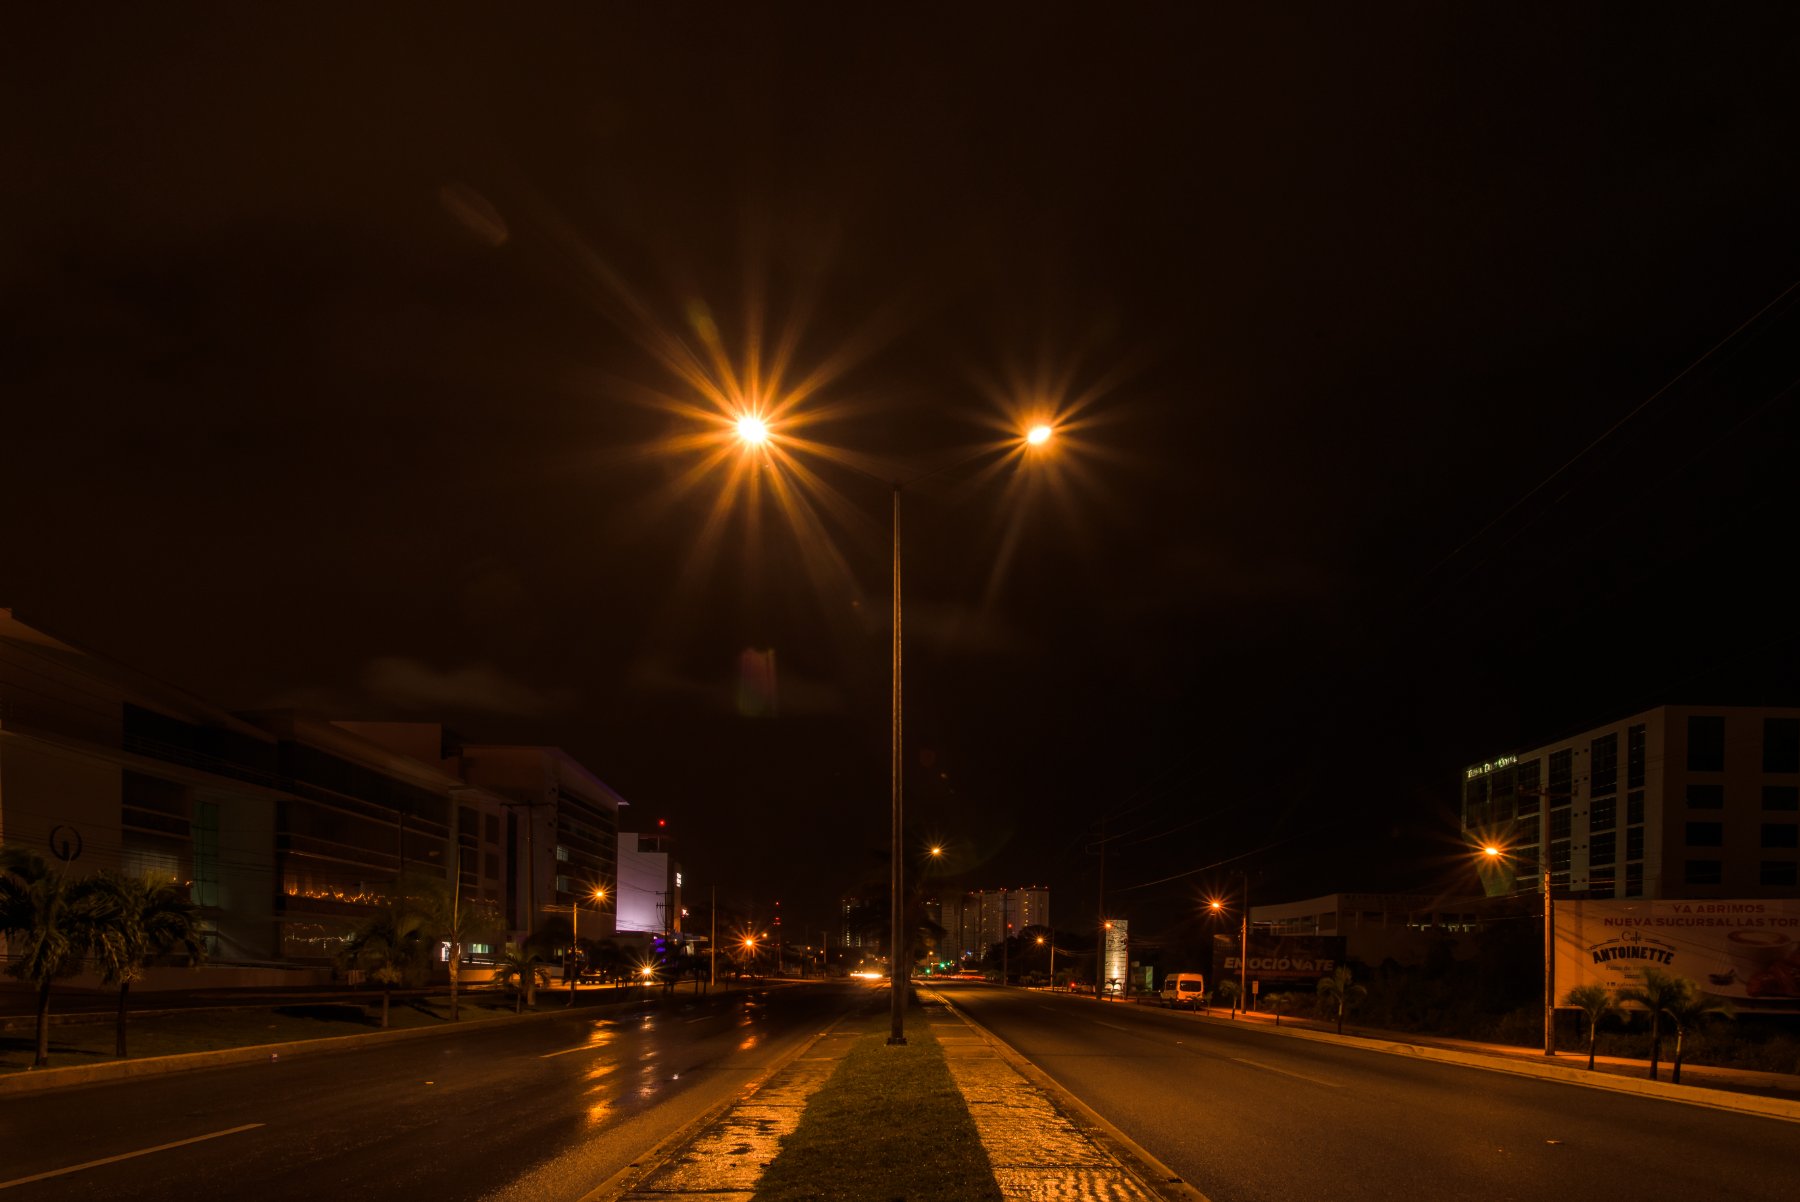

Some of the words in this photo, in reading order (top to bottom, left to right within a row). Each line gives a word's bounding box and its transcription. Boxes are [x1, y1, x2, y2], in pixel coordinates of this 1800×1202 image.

[1672, 904, 1692, 913] YA
[1696, 904, 1765, 913] ABRIMOS
[1604, 918, 1653, 927] NUEVA
[1655, 918, 1733, 927] SUCURSAL
[1736, 918, 1765, 927] LAS
[1593, 946, 1675, 965] ANTOINETTE
